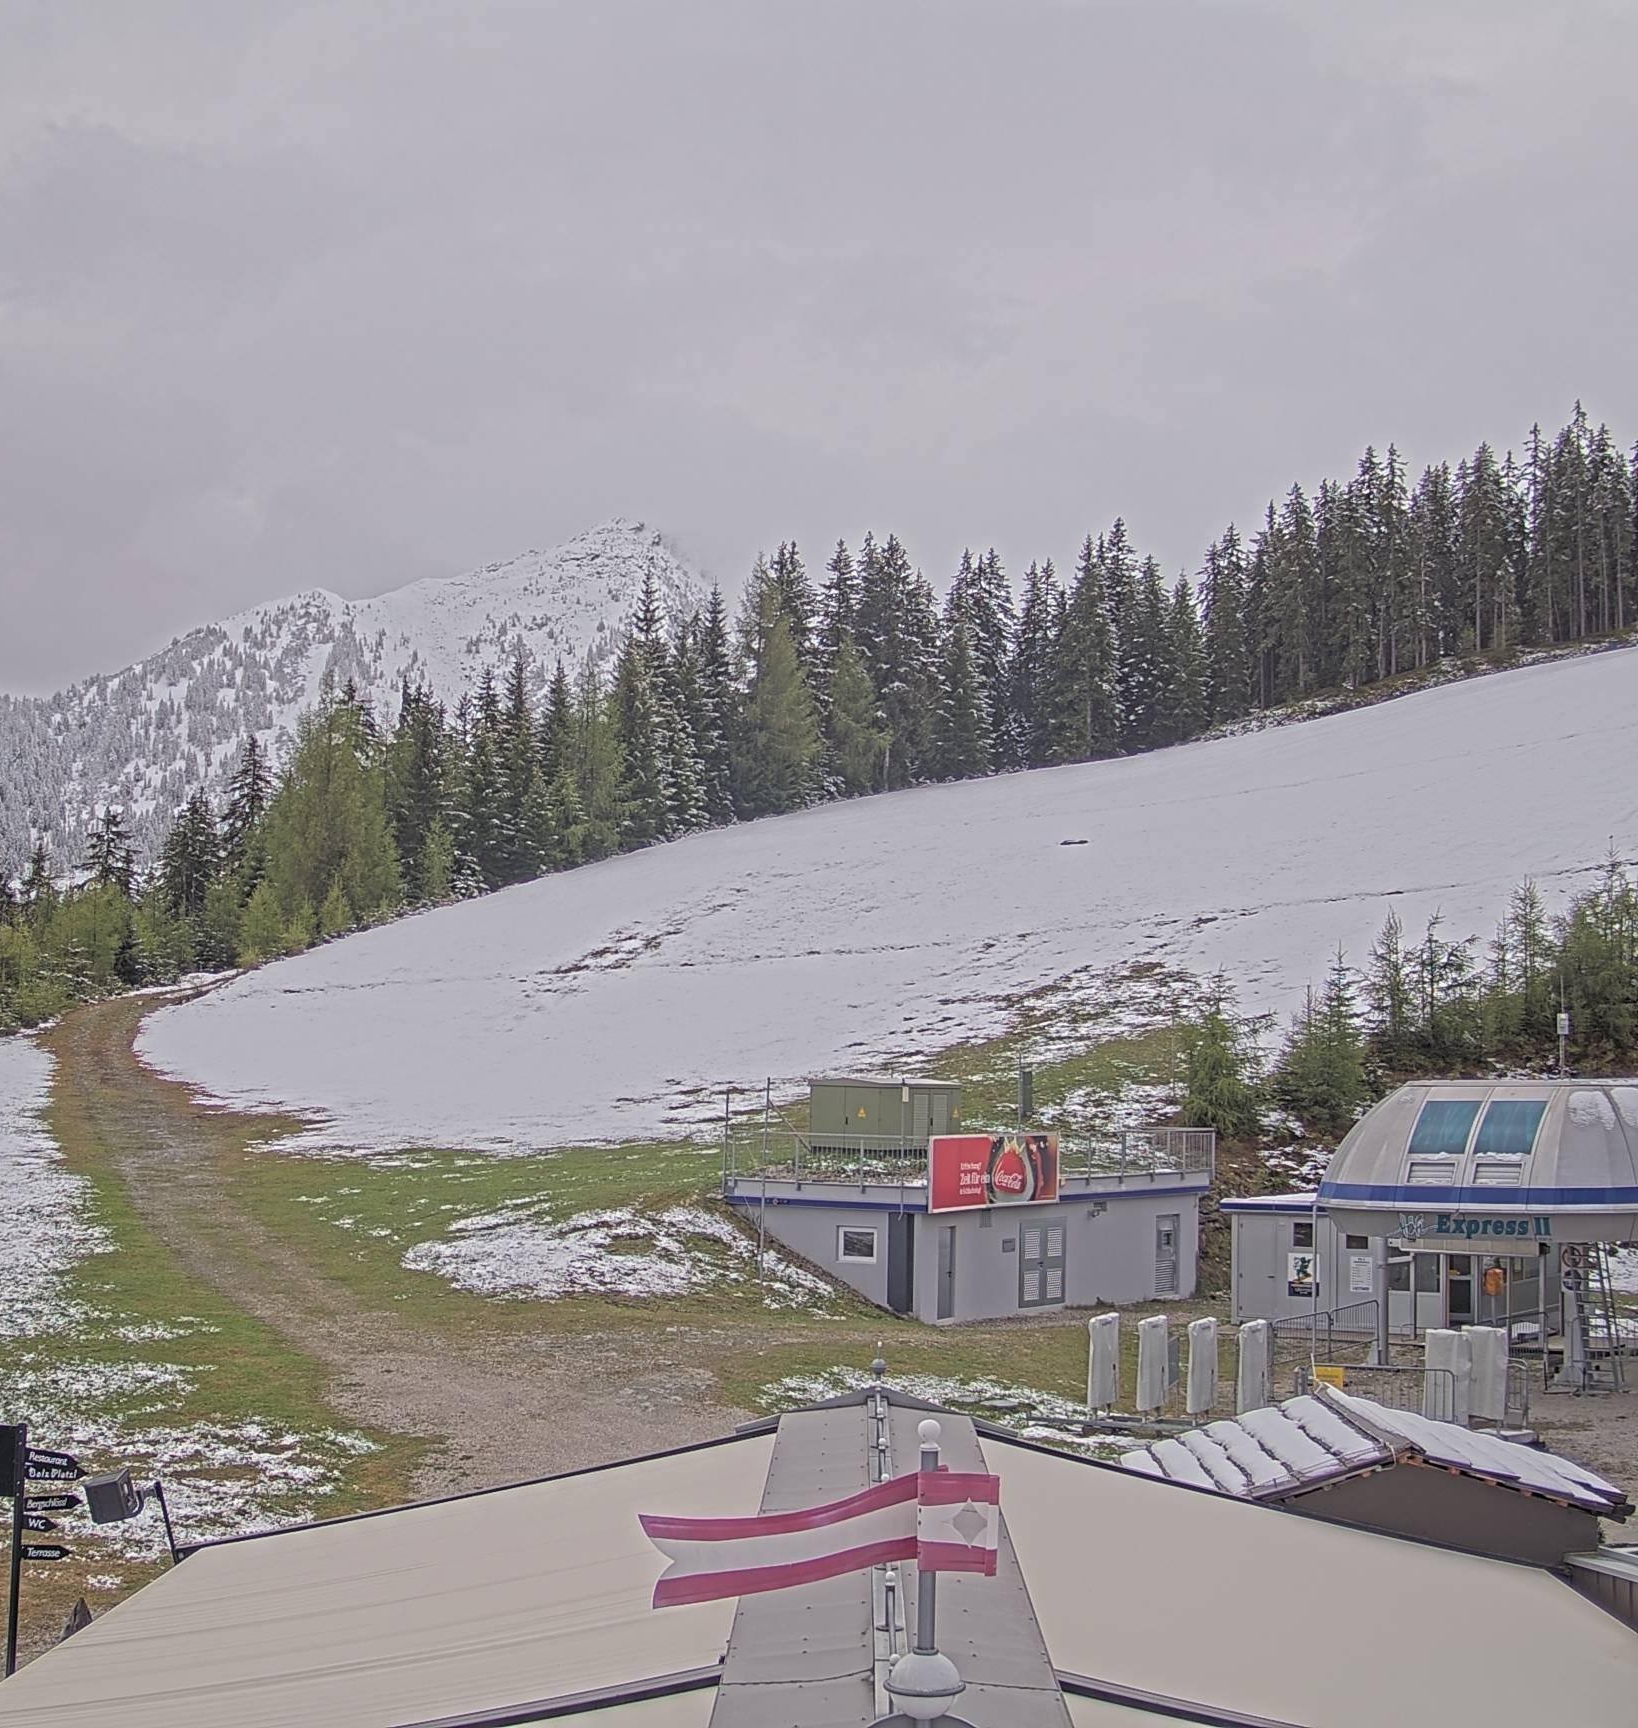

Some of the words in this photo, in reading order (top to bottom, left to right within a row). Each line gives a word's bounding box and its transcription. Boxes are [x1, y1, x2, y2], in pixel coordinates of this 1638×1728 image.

[1437, 1215, 1529, 1239] Express
[29, 1451, 68, 1466] Restaurant
[28, 1518, 46, 1529] WC
[27, 1547, 61, 1557] Terrasse
